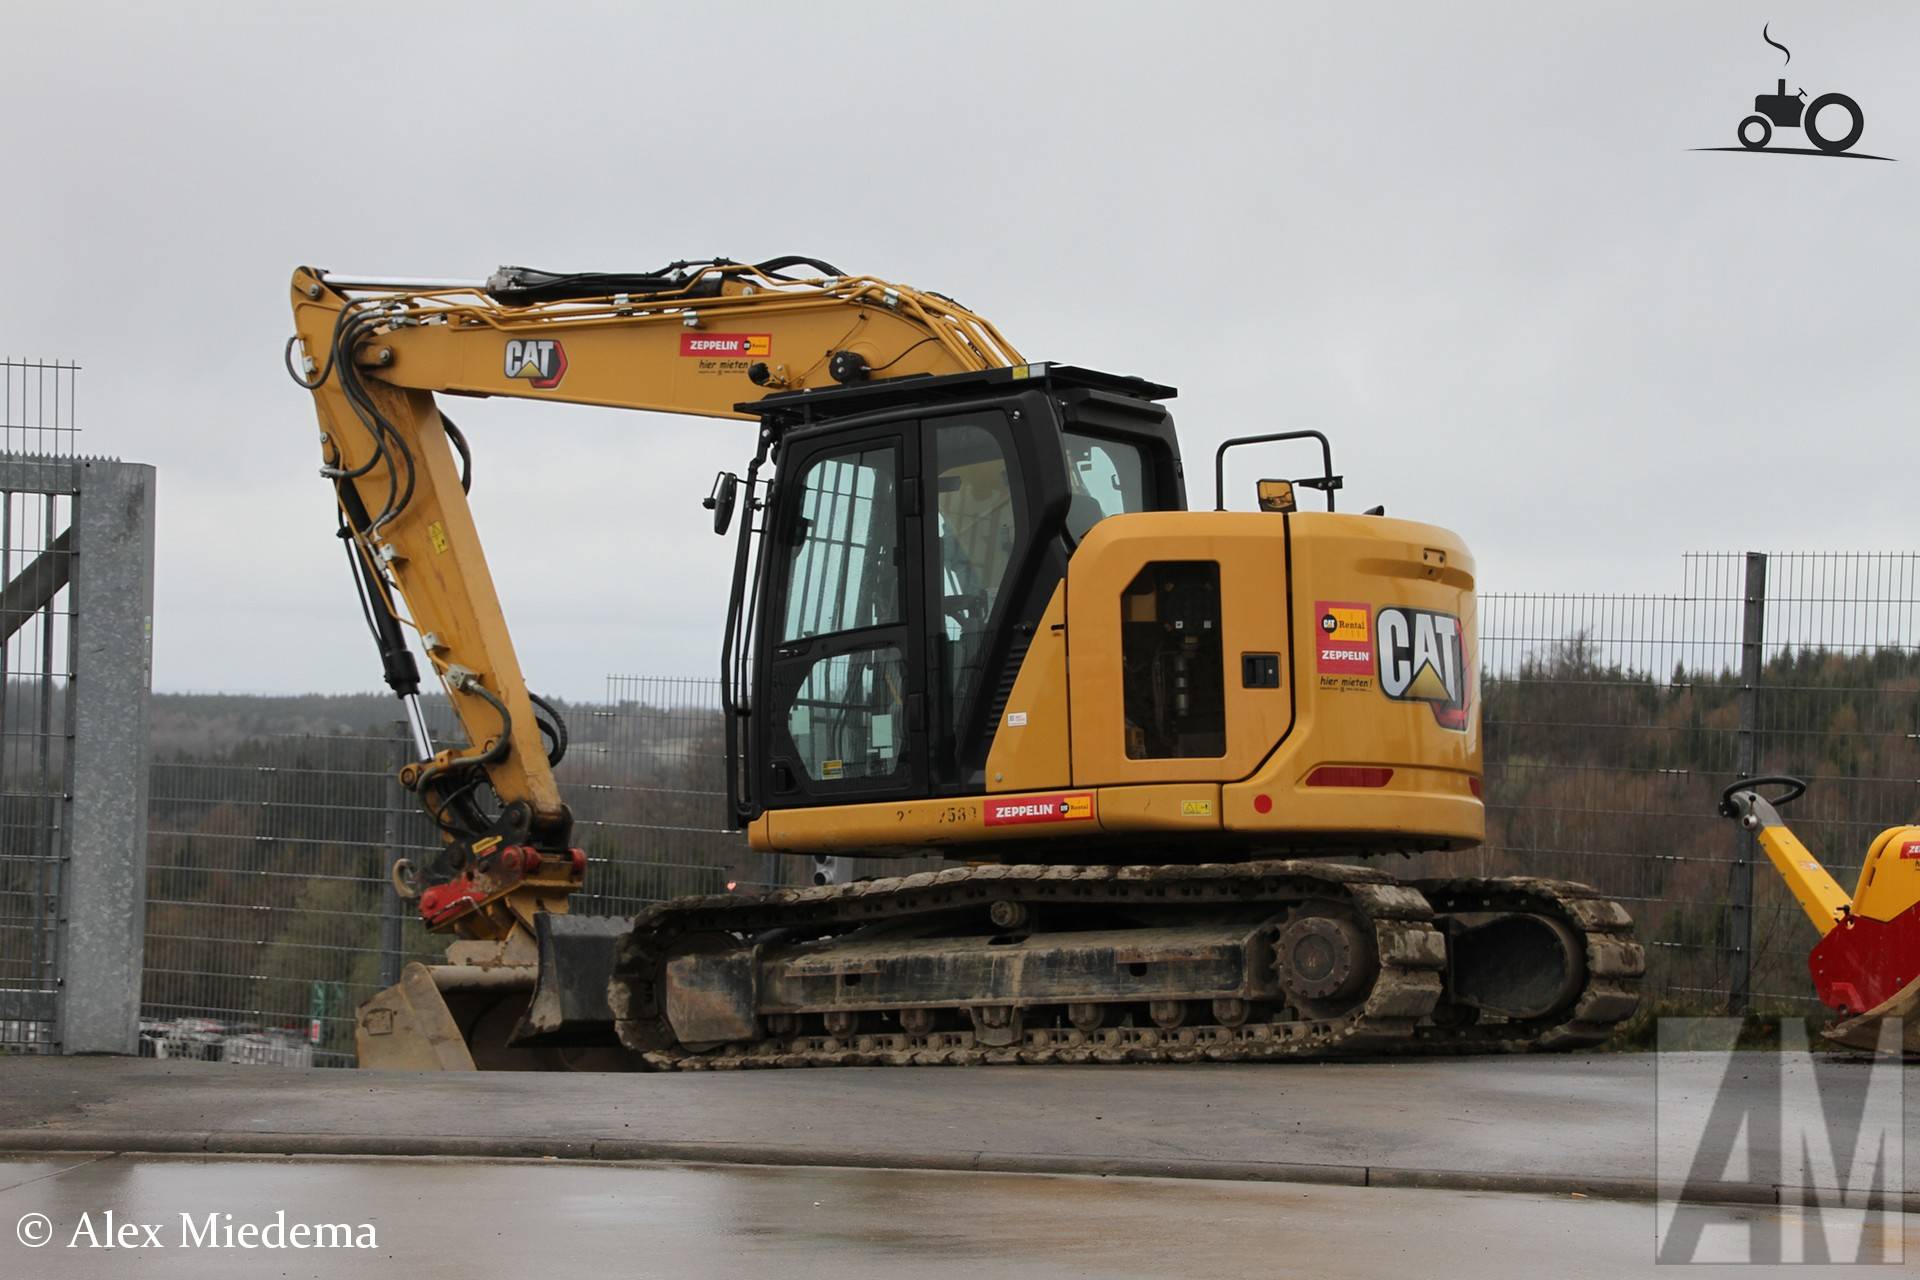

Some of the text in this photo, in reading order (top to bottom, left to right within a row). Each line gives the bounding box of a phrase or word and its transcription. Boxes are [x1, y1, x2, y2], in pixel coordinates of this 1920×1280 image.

[690, 340, 738, 351] ZEPPELIN
[505, 339, 554, 379] CAT
[699, 359, 716, 369] hier
[1338, 620, 1366, 630] Rental
[1321, 649, 1369, 661] ZEPPELIN
[1377, 608, 1456, 702] CAT
[1320, 676, 1338, 686] hier
[995, 803, 1053, 818] ZEPPELIN
